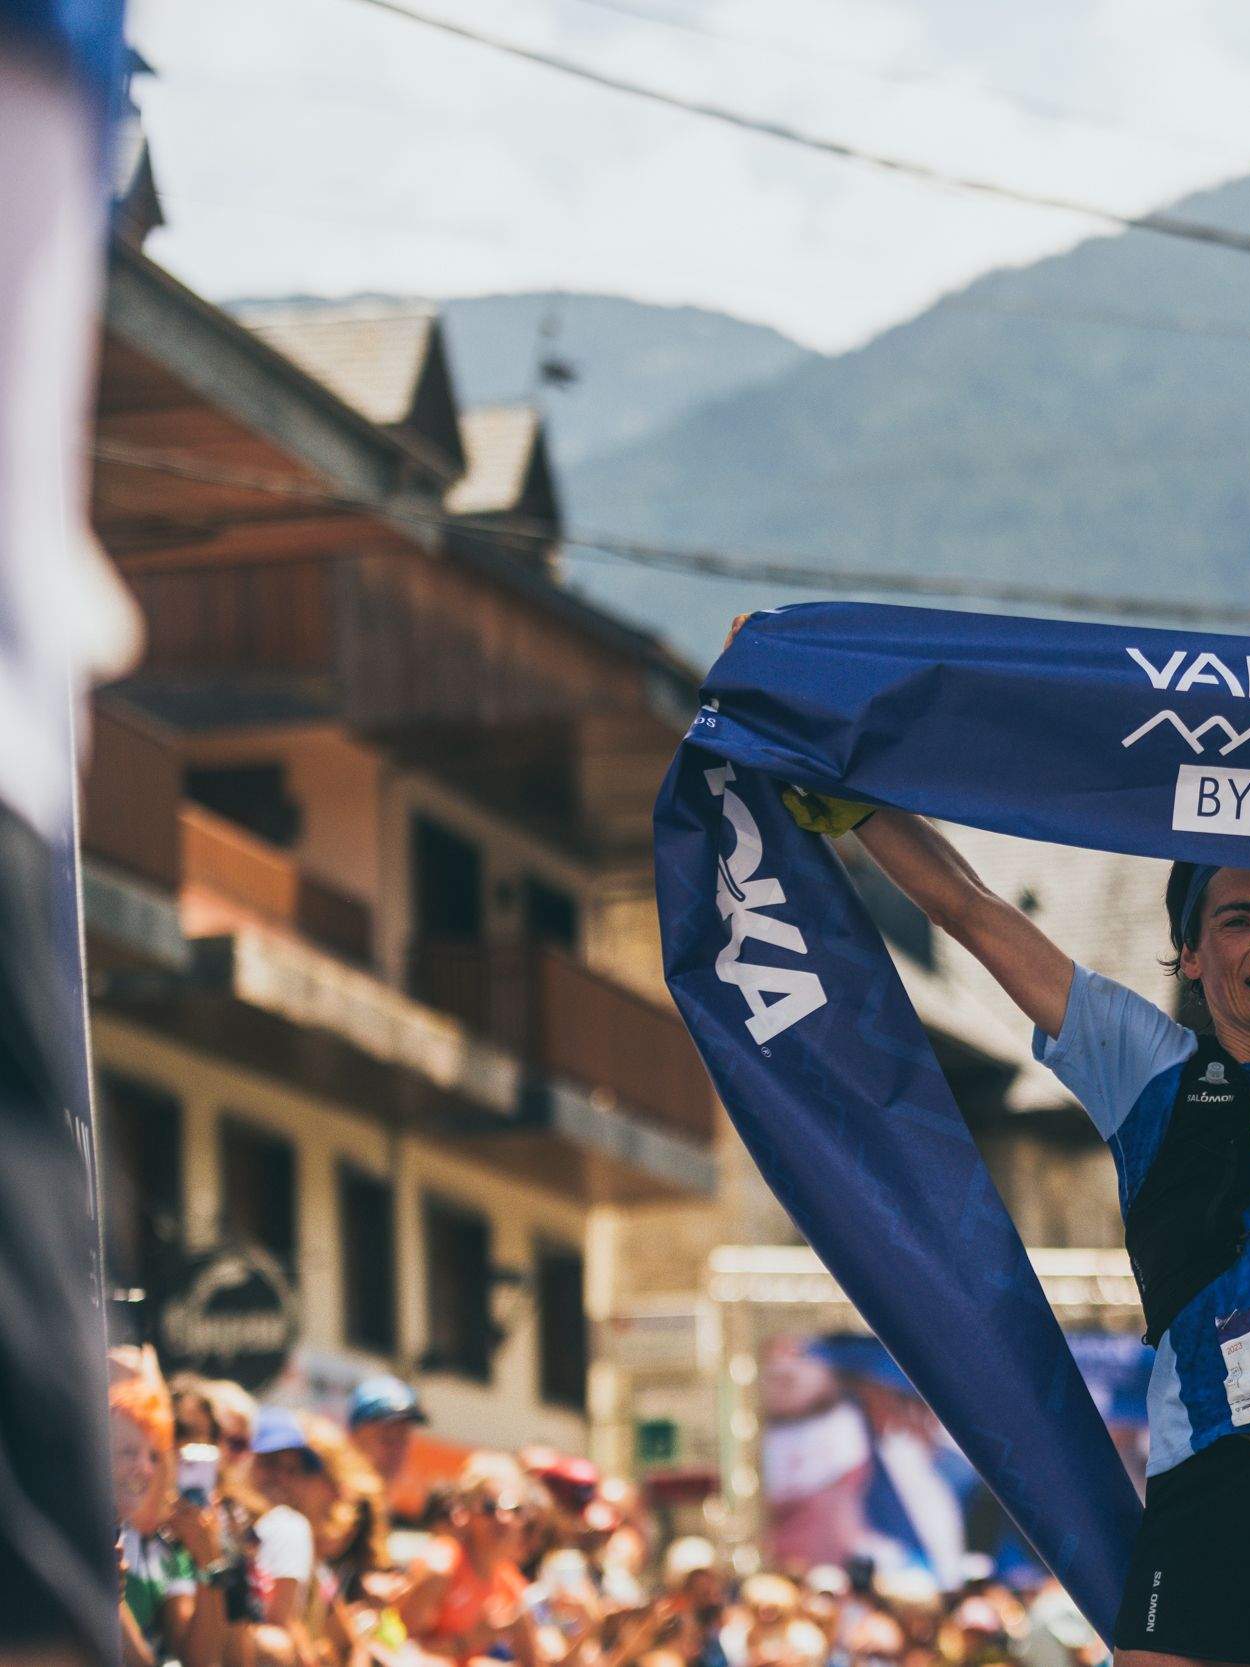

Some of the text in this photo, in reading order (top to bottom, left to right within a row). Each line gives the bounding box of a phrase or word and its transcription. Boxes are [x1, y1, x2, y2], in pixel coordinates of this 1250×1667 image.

[704, 762, 828, 1046] OKA
[1187, 1091, 1235, 1103] SALOMON
[1146, 1571, 1162, 1632] SAOMON
